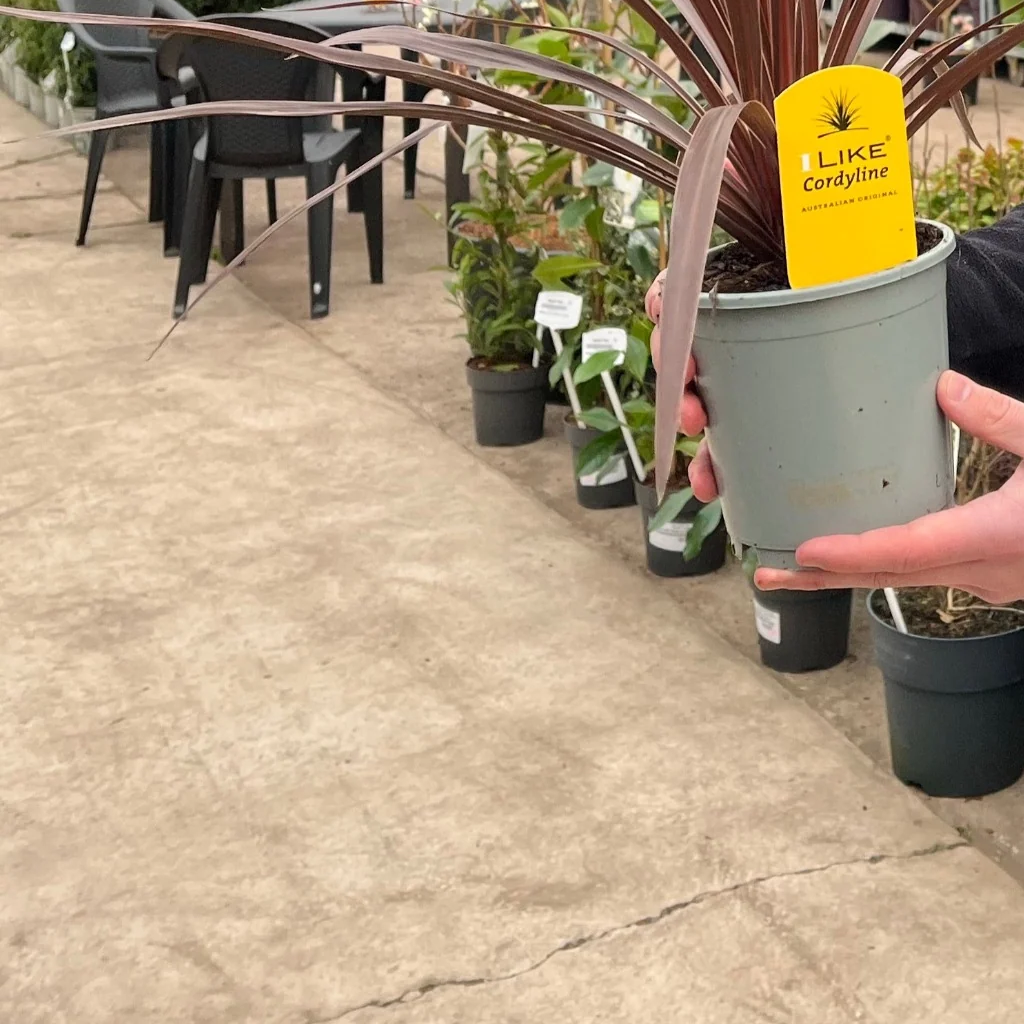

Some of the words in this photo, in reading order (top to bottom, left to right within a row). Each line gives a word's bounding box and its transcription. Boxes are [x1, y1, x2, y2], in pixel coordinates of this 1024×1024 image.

[799, 153, 812, 173] I
[818, 142, 887, 169] LIKE
[803, 166, 889, 192] Cordyline
[801, 197, 855, 213] AUSTRALIAN
[858, 189, 898, 202] ORIGINAL
